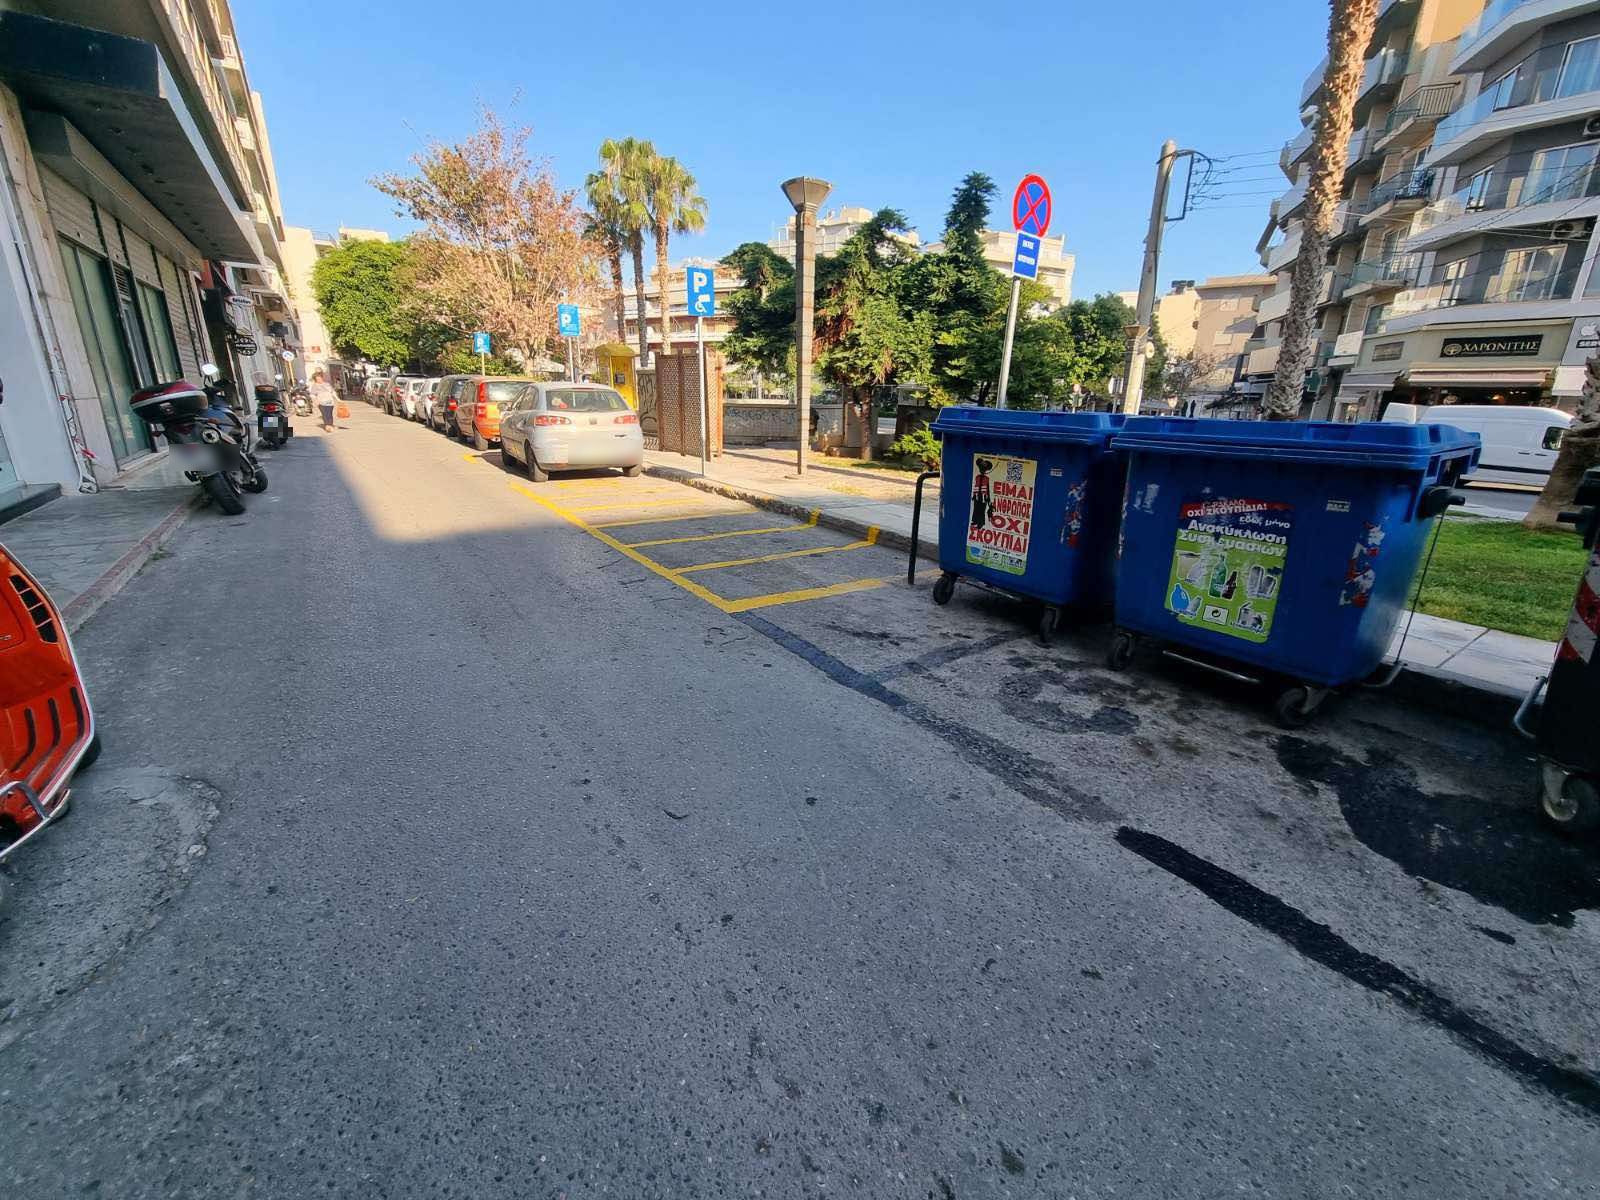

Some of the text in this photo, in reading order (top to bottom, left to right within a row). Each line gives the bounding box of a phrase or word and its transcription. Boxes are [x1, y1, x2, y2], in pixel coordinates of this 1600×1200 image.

[693, 272, 707, 293] P
[561, 313, 573, 328] P
[1462, 341, 1538, 352] ΧΑΡΩΝΙΤΗΣ
[993, 481, 1033, 500] ΕΙΜΑΙ
[991, 498, 1031, 519] ΑΝΘΡΩΠΟΣ
[1187, 508, 1204, 518] ΟΧΙ
[990, 515, 1029, 535] ΟΧΙ
[1187, 519, 1287, 545] Ανακύκλωση
[968, 526, 1027, 554] ΣΚΟΥΠΙΔΙ
